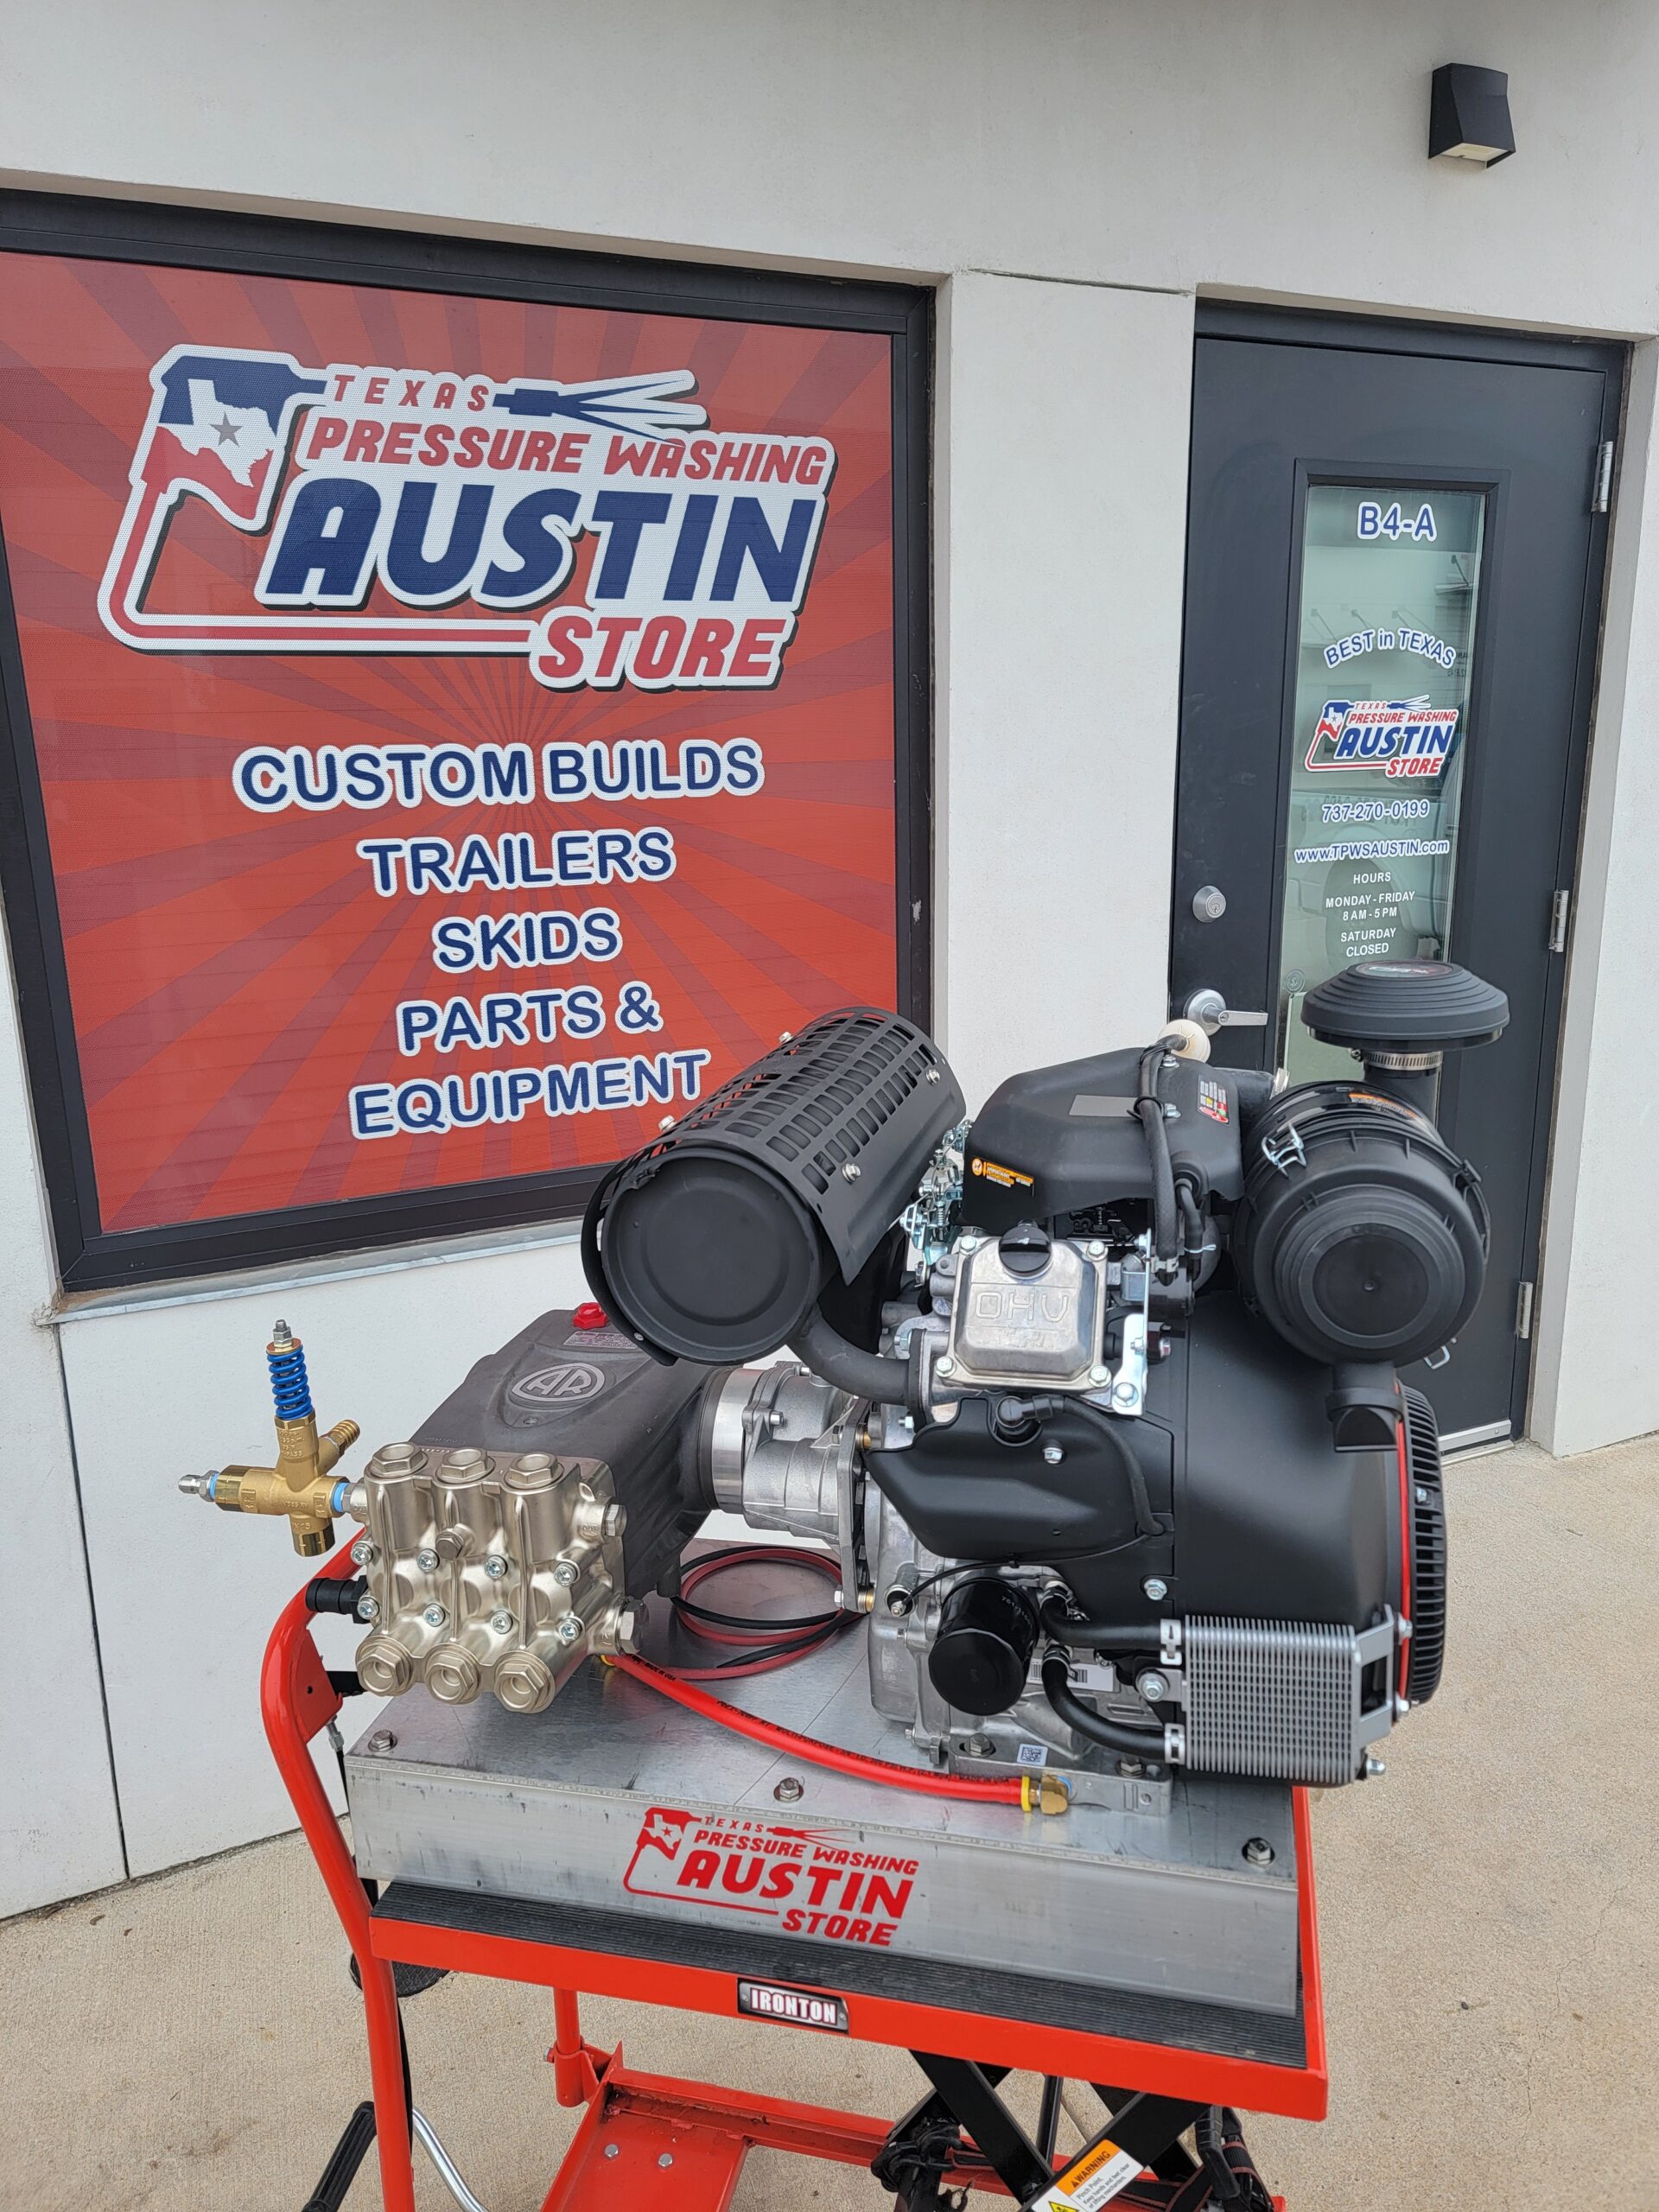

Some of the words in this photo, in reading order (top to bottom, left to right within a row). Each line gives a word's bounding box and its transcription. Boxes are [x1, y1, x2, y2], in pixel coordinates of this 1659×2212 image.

[334, 374, 489, 411] TEXAS
[306, 417, 590, 474] PRESSURE
[603, 436, 828, 485] WASHING
[1360, 505, 1434, 537] B4-A
[265, 477, 817, 602] AUSTIN
[537, 614, 787, 679] STORE
[1325, 632, 1375, 666] BEST
[1379, 630, 1393, 648] in
[1400, 630, 1454, 666] TEXAS
[1348, 712, 1403, 724] PRESSURE
[1408, 711, 1458, 724] WASHING
[1336, 726, 1454, 757] AUSTIN
[242, 751, 528, 804] CUSTOM
[550, 745, 760, 794] BUILDS
[1387, 758, 1443, 776] STORE
[1322, 801, 1429, 822] 737-270-0199
[363, 832, 672, 892] TRAILERS
[1296, 841, 1448, 861] www.TPWSAUSTIN.com
[1353, 872, 1391, 884] HOURS
[1325, 895, 1371, 908] MONDAY
[1379, 891, 1415, 903] FRIDAY
[1343, 911, 1349, 921] 8
[1351, 910, 1367, 920] AM
[1375, 909, 1380, 918] 5
[1382, 907, 1397, 918] PM
[438, 912, 618, 968] SKIDS
[1340, 928, 1396, 942] SATURDAY
[1346, 943, 1389, 957] CLOSED
[403, 990, 602, 1052] PARTS
[620, 986, 658, 1030] &
[357, 1053, 707, 1135] EQUIPMENT
[976, 1292, 1069, 1323] OHV
[526, 1369, 592, 1396] AR
[704, 1815, 765, 1834] TEXAS
[694, 1829, 807, 1859] PRESSURE
[812, 1847, 919, 1875] WASHING
[677, 1850, 914, 1919] AUSTIN
[782, 1908, 898, 1946] STORE
[750, 1987, 838, 2024] IRONTON
[1076, 2151, 1111, 2183] WARNING
